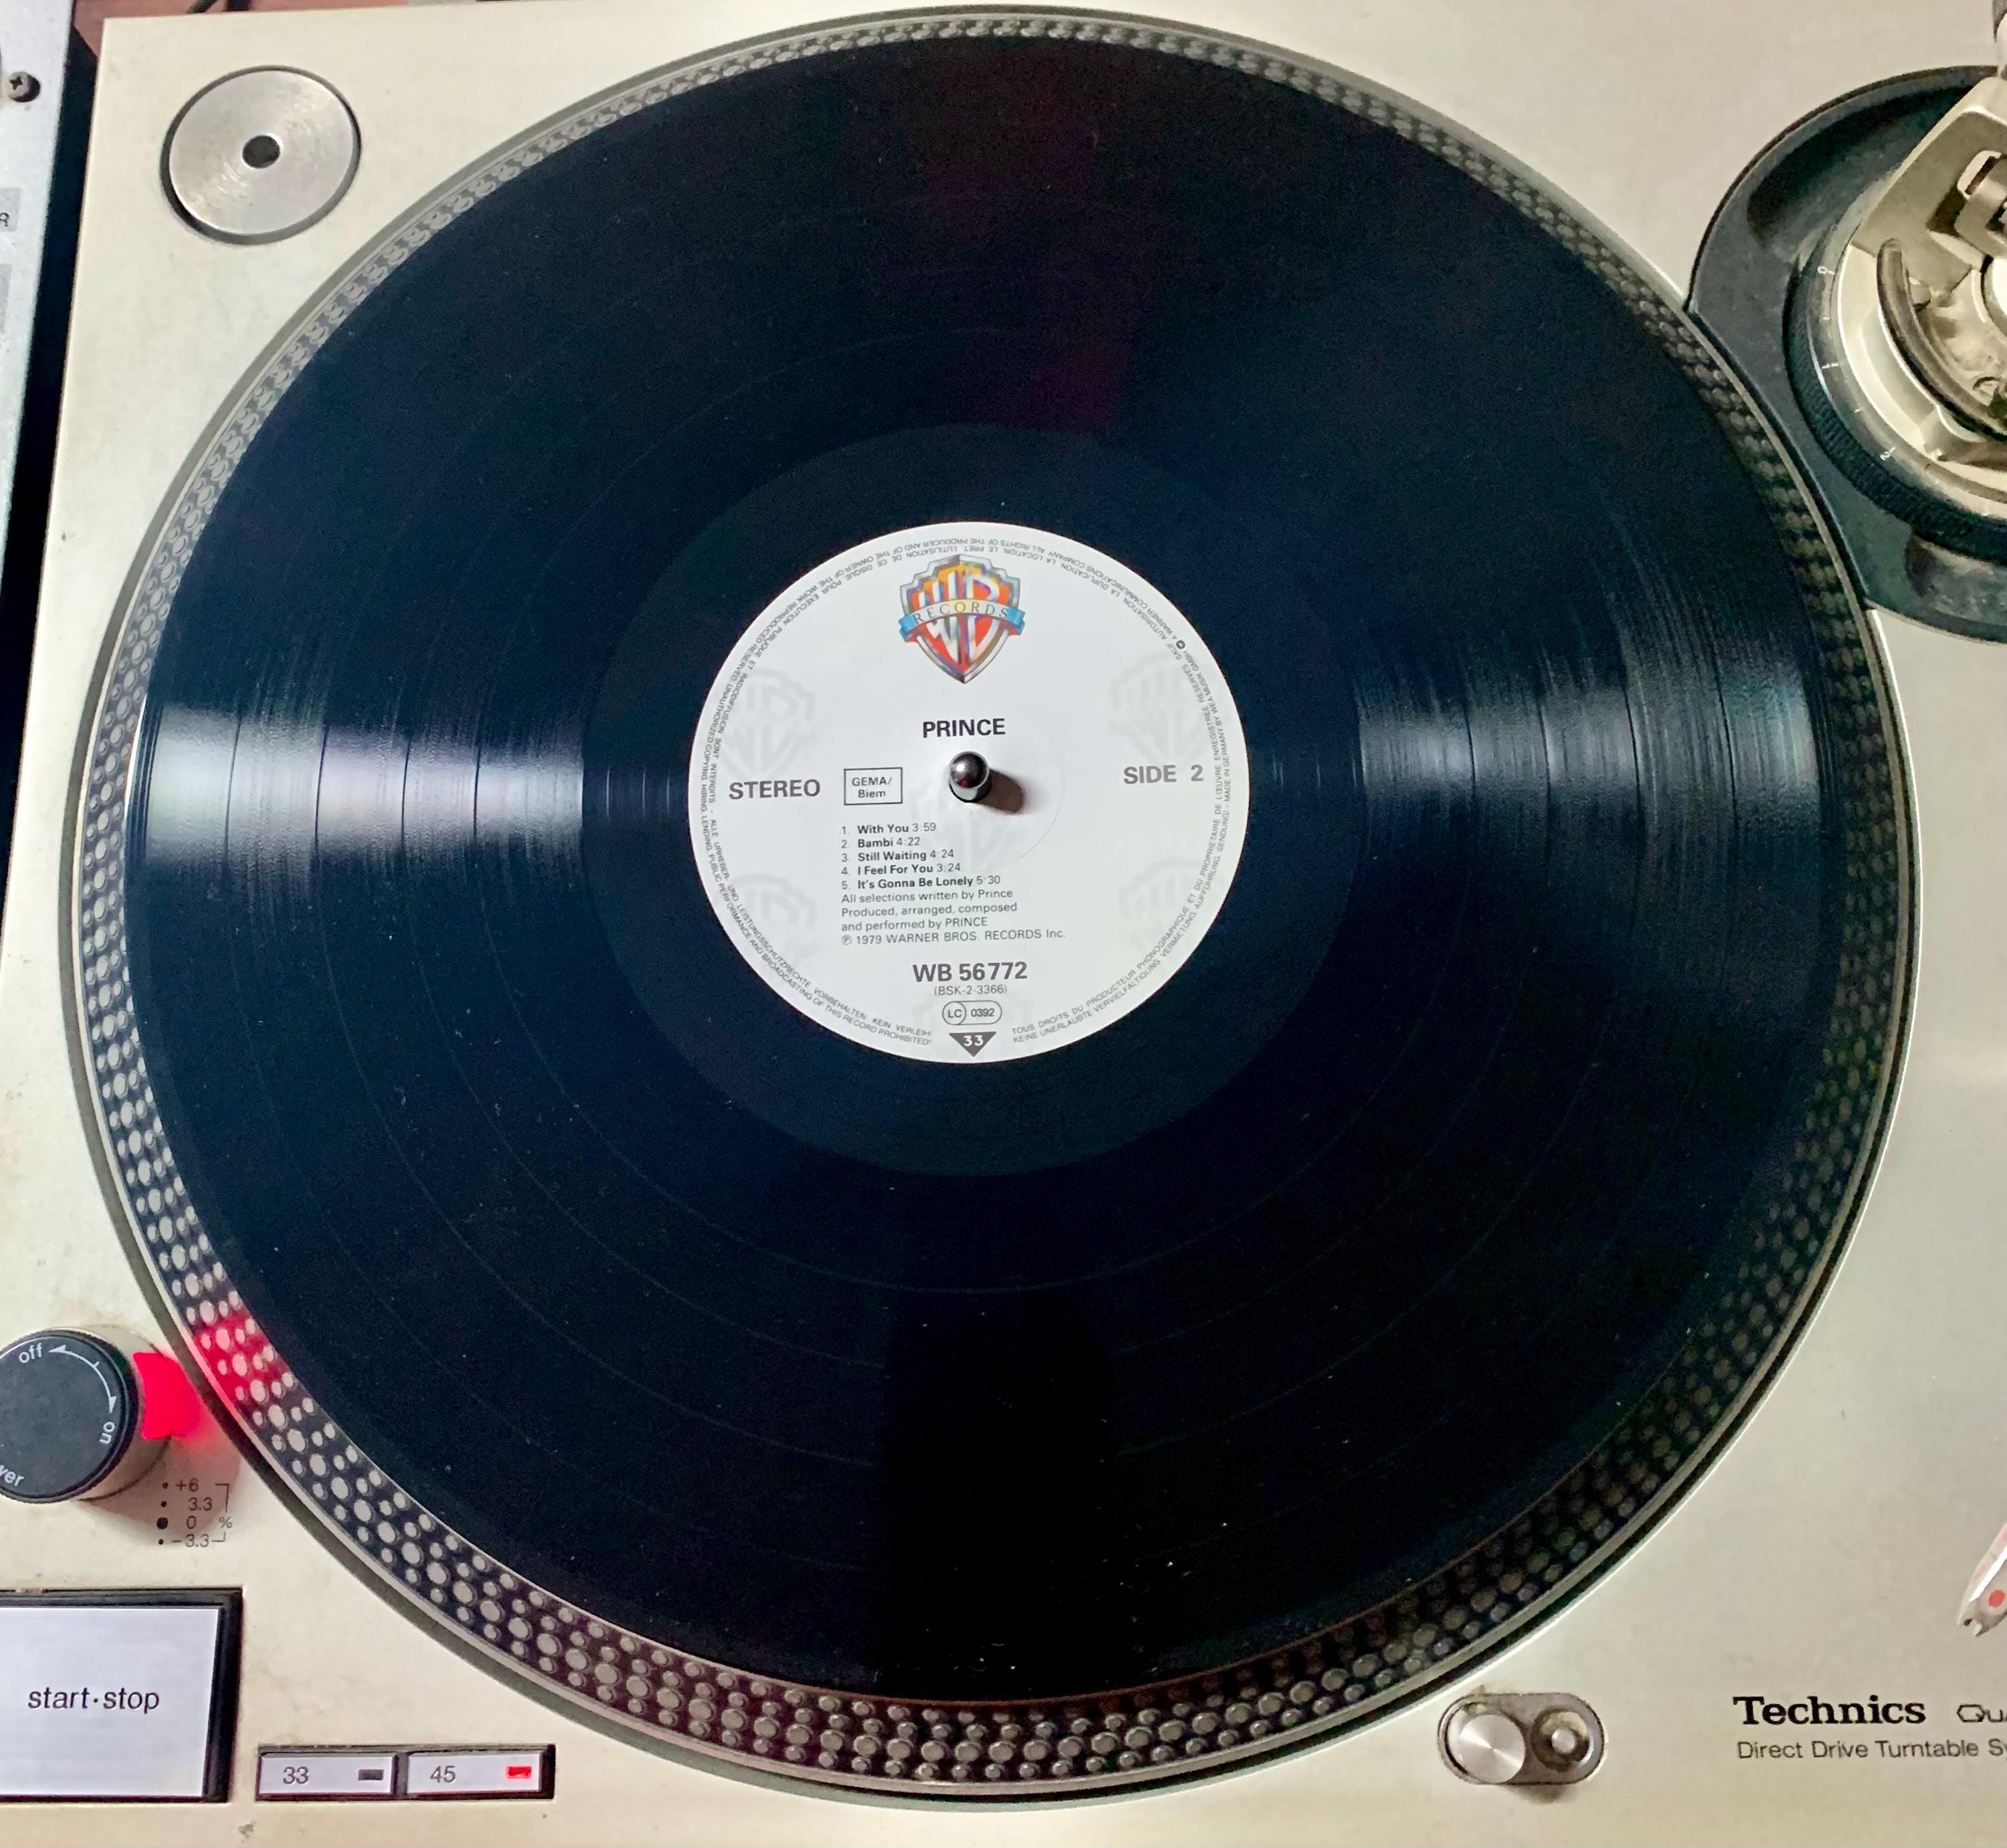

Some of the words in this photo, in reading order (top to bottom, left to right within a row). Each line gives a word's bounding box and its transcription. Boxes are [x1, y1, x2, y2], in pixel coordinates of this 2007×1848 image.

[904, 542, 921, 551] AND
[922, 537, 967, 548] PRODUCER
[1000, 539, 1030, 550] RIGHTS
[1031, 545, 1046, 554] ALL
[874, 549, 890, 560] THE
[891, 554, 902, 562] DE
[892, 546, 903, 555] OF
[844, 555, 874, 573] OWNER
[876, 558, 887, 567] CE
[1045, 557, 1056, 565] LA
[833, 568, 845, 579] OF
[844, 564, 872, 581] DISQUE
[818, 575, 833, 587] THE
[821, 579, 842, 595] POUR
[1085, 565, 1148, 610] COMMUNICATIONS
[796, 584, 818, 603] WORK
[1109, 588, 1120, 597] LA
[782, 593, 820, 626] EXECUTION
[913, 601, 1010, 625] RECORDS
[755, 600, 797, 644] REPRODUCED
[1146, 607, 1173, 635] WARNER
[746, 660, 756, 670] ET
[717, 672, 749, 733] RADIODIFFUSION
[706, 683, 733, 743] UNAUTHORIZED
[1213, 715, 1222, 726] BY
[923, 718, 1006, 738] PRINCE
[1201, 706, 1220, 760] ENREGISTREE
[712, 737, 722, 758] SONT
[1217, 728, 1230, 766] GERMANY
[1123, 767, 1177, 785] SIDE
[1191, 765, 1204, 783] 2
[729, 779, 821, 800] STEREO
[858, 789, 886, 799] Biem
[1214, 804, 1221, 814] DE
[710, 818, 719, 837] ALLE
[857, 824, 884, 834] With
[887, 824, 909, 834] You
[911, 822, 937, 832] 3:59
[858, 838, 893, 848] Bambi
[896, 837, 921, 846] 4:22
[1200, 819, 1220, 876] PROPRIETAIRE
[858, 852, 880, 862] Still
[883, 850, 927, 861] Waiting
[930, 849, 954, 858] 4:24
[708, 854, 723, 883] PUBLIC
[858, 866, 861, 875] I
[864, 865, 887, 874] Feel
[890, 864, 909, 874] For
[911, 864, 933, 874] You
[937, 862, 961, 872] 3:24
[878, 879, 916, 889] Gonna
[919, 878, 933, 887] Be
[936, 876, 973, 889] Lonely
[976, 875, 1001, 885] 5:30
[1193, 878, 1204, 891] DU
[727, 884, 739, 901] UND
[842, 894, 856, 903] All
[859, 892, 916, 903] selections
[919, 891, 958, 901] written
[961, 890, 975, 901] by
[977, 889, 1013, 899] Prince
[1187, 893, 1197, 904] ET
[717, 883, 752, 939] PERFORMANCE
[842, 907, 898, 917] Produced,
[958, 903, 1018, 915] composed
[842, 922, 862, 931] and
[866, 920, 925, 932] performed
[928, 919, 942, 931] by
[945, 917, 988, 927] PRINCE
[856, 935, 882, 945] 1979
[886, 933, 940, 944] WARNER
[985, 929, 1042, 941] RECORDS
[1046, 929, 1066, 939] Inc.
[1136, 905, 1189, 970] PHONOGRAPHIQUE
[736, 903, 811, 988] LEISTUNGSSCHUTZRECHTE
[748, 937, 764, 955] AND
[760, 953, 814, 1000] BROADCASTING
[912, 963, 953, 982] WB
[959, 961, 1028, 981] 56772
[934, 984, 1008, 996] (BSK-2-3366)
[1085, 969, 1137, 1007] PRODUCTEUR
[811, 997, 824, 1008] OF
[1070, 1004, 1084, 1015] DU
[824, 1004, 843, 1018] THIS
[947, 1009, 962, 1018] LC
[971, 1008, 995, 1017] 0392
[842, 1014, 877, 1033] RECORD
[871, 1017, 891, 1028] KEIN
[1038, 1011, 1069, 1028] DROITS
[1039, 1009, 1093, 1036] UNERLAUBTE
[1012, 1023, 1035, 1034] TOUS
[1013, 1030, 1038, 1042] KEINE
[963, 1034, 984, 1047] 33
[18, 1343, 43, 1364] off
[98, 1420, 116, 1445] on
[176, 1477, 199, 1491] +6
[189, 1497, 213, 1511] 3.3
[187, 1515, 197, 1530] 0
[219, 1516, 233, 1529] %
[1733, 1694, 1927, 1725] Technics
[1737, 1740, 1804, 1759] Direct
[1812, 1740, 1869, 1758] Drive
[1875, 1739, 1980, 1758] Turntable
[282, 1766, 310, 1784] 33
[429, 1766, 457, 1784] 45
